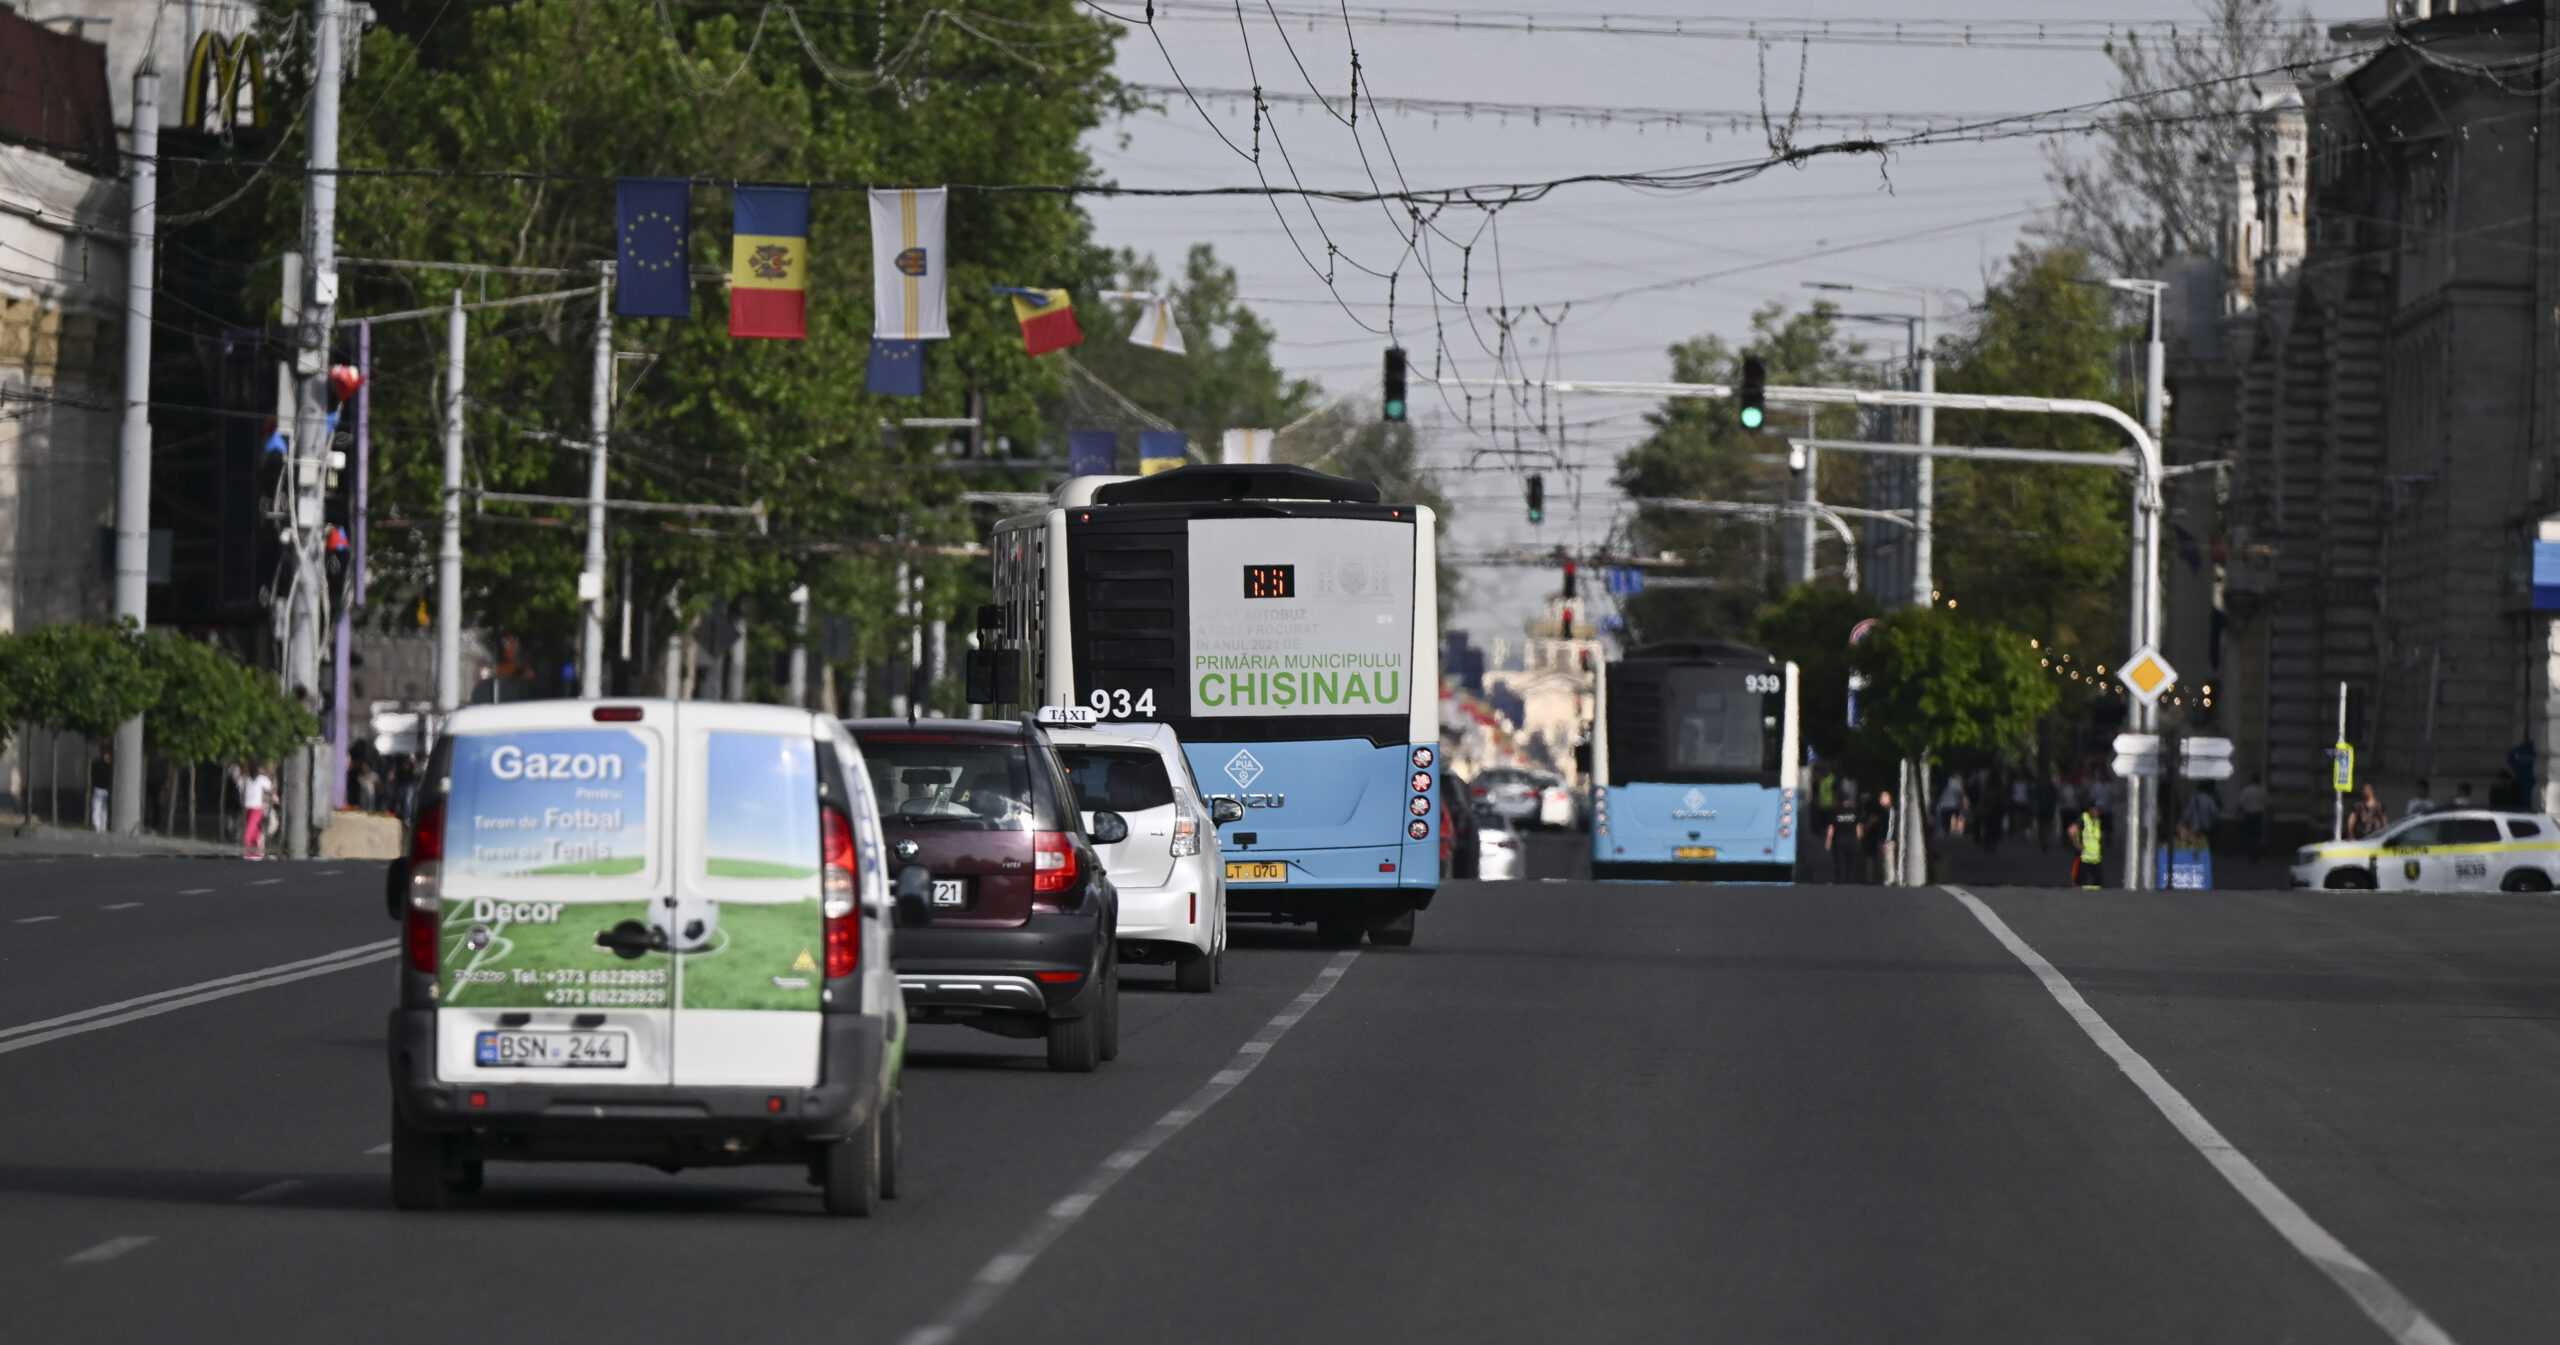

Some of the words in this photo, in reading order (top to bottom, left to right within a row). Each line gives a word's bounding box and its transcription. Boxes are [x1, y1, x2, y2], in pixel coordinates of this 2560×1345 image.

[1245, 608, 1308, 620] AUTOBUZ
[1246, 623, 1319, 636] PROCURAT
[1213, 639, 1248, 651] ANUL
[1251, 638, 1280, 650] 2021
[1283, 638, 1301, 650] DE
[1195, 652, 1280, 670] PRIMĂRIA
[1284, 653, 1402, 669] MUNICIPIULUI
[1745, 674, 1780, 693] 939
[1090, 688, 1157, 718] 934
[1049, 710, 1087, 720] TAXI
[491, 745, 623, 779] Gazon
[1235, 760, 1254, 769] PUA
[545, 808, 623, 830] Fotbal
[545, 837, 613, 862] Tenis
[1253, 865, 1278, 877] 070
[474, 898, 565, 922] Decor
[545, 988, 585, 1004] +373
[500, 1036, 548, 1059] BSN
[569, 1037, 612, 1059] 244
